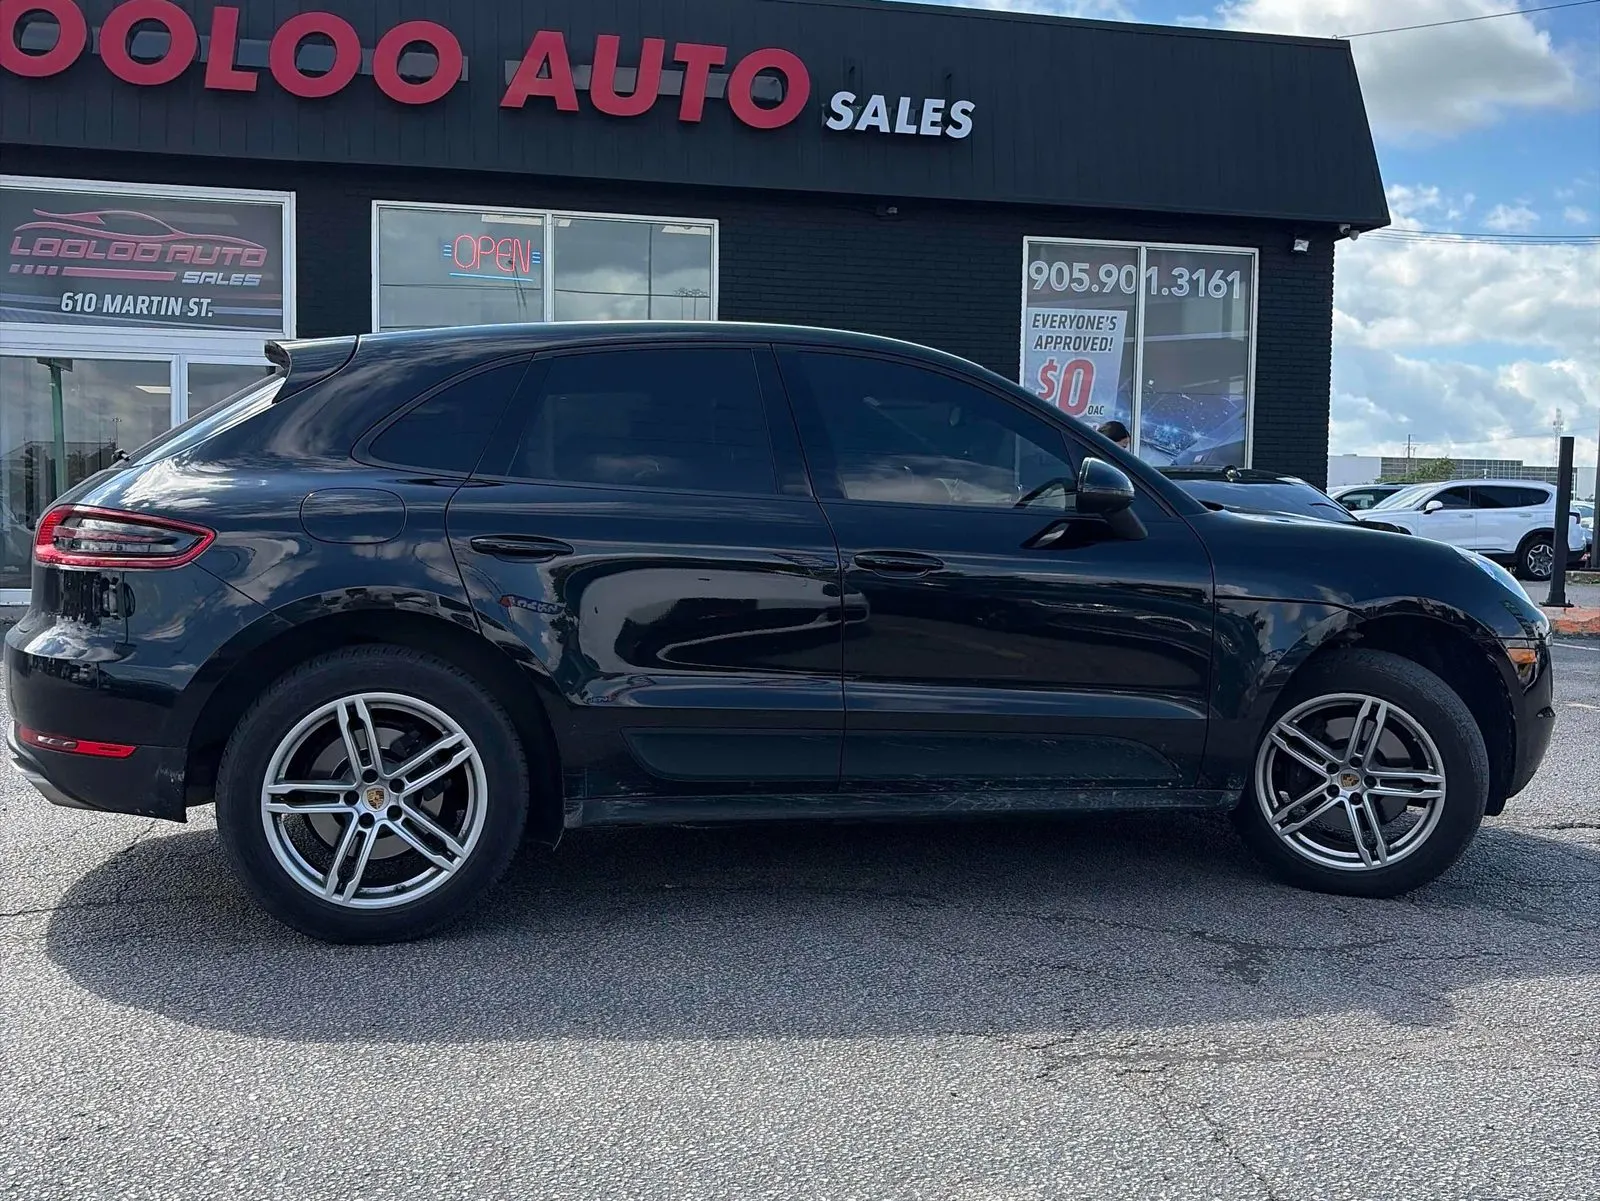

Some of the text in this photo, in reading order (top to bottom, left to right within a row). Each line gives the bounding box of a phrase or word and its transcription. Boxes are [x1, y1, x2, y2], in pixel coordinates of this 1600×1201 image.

[500, 30, 810, 129] AUTO
[825, 91, 976, 139] SALES
[10, 236, 267, 267] LOOLOO AUTO
[454, 234, 531, 273] OPEN
[182, 271, 263, 286] SALES
[1029, 260, 1241, 299] 905.901.3161
[60, 292, 214, 318] 610 MARTIN ST.
[1032, 313, 1118, 331] EVERYONE'S
[1033, 335, 1114, 353] APPROVED!
[1038, 358, 1105, 417] $0 OAC
